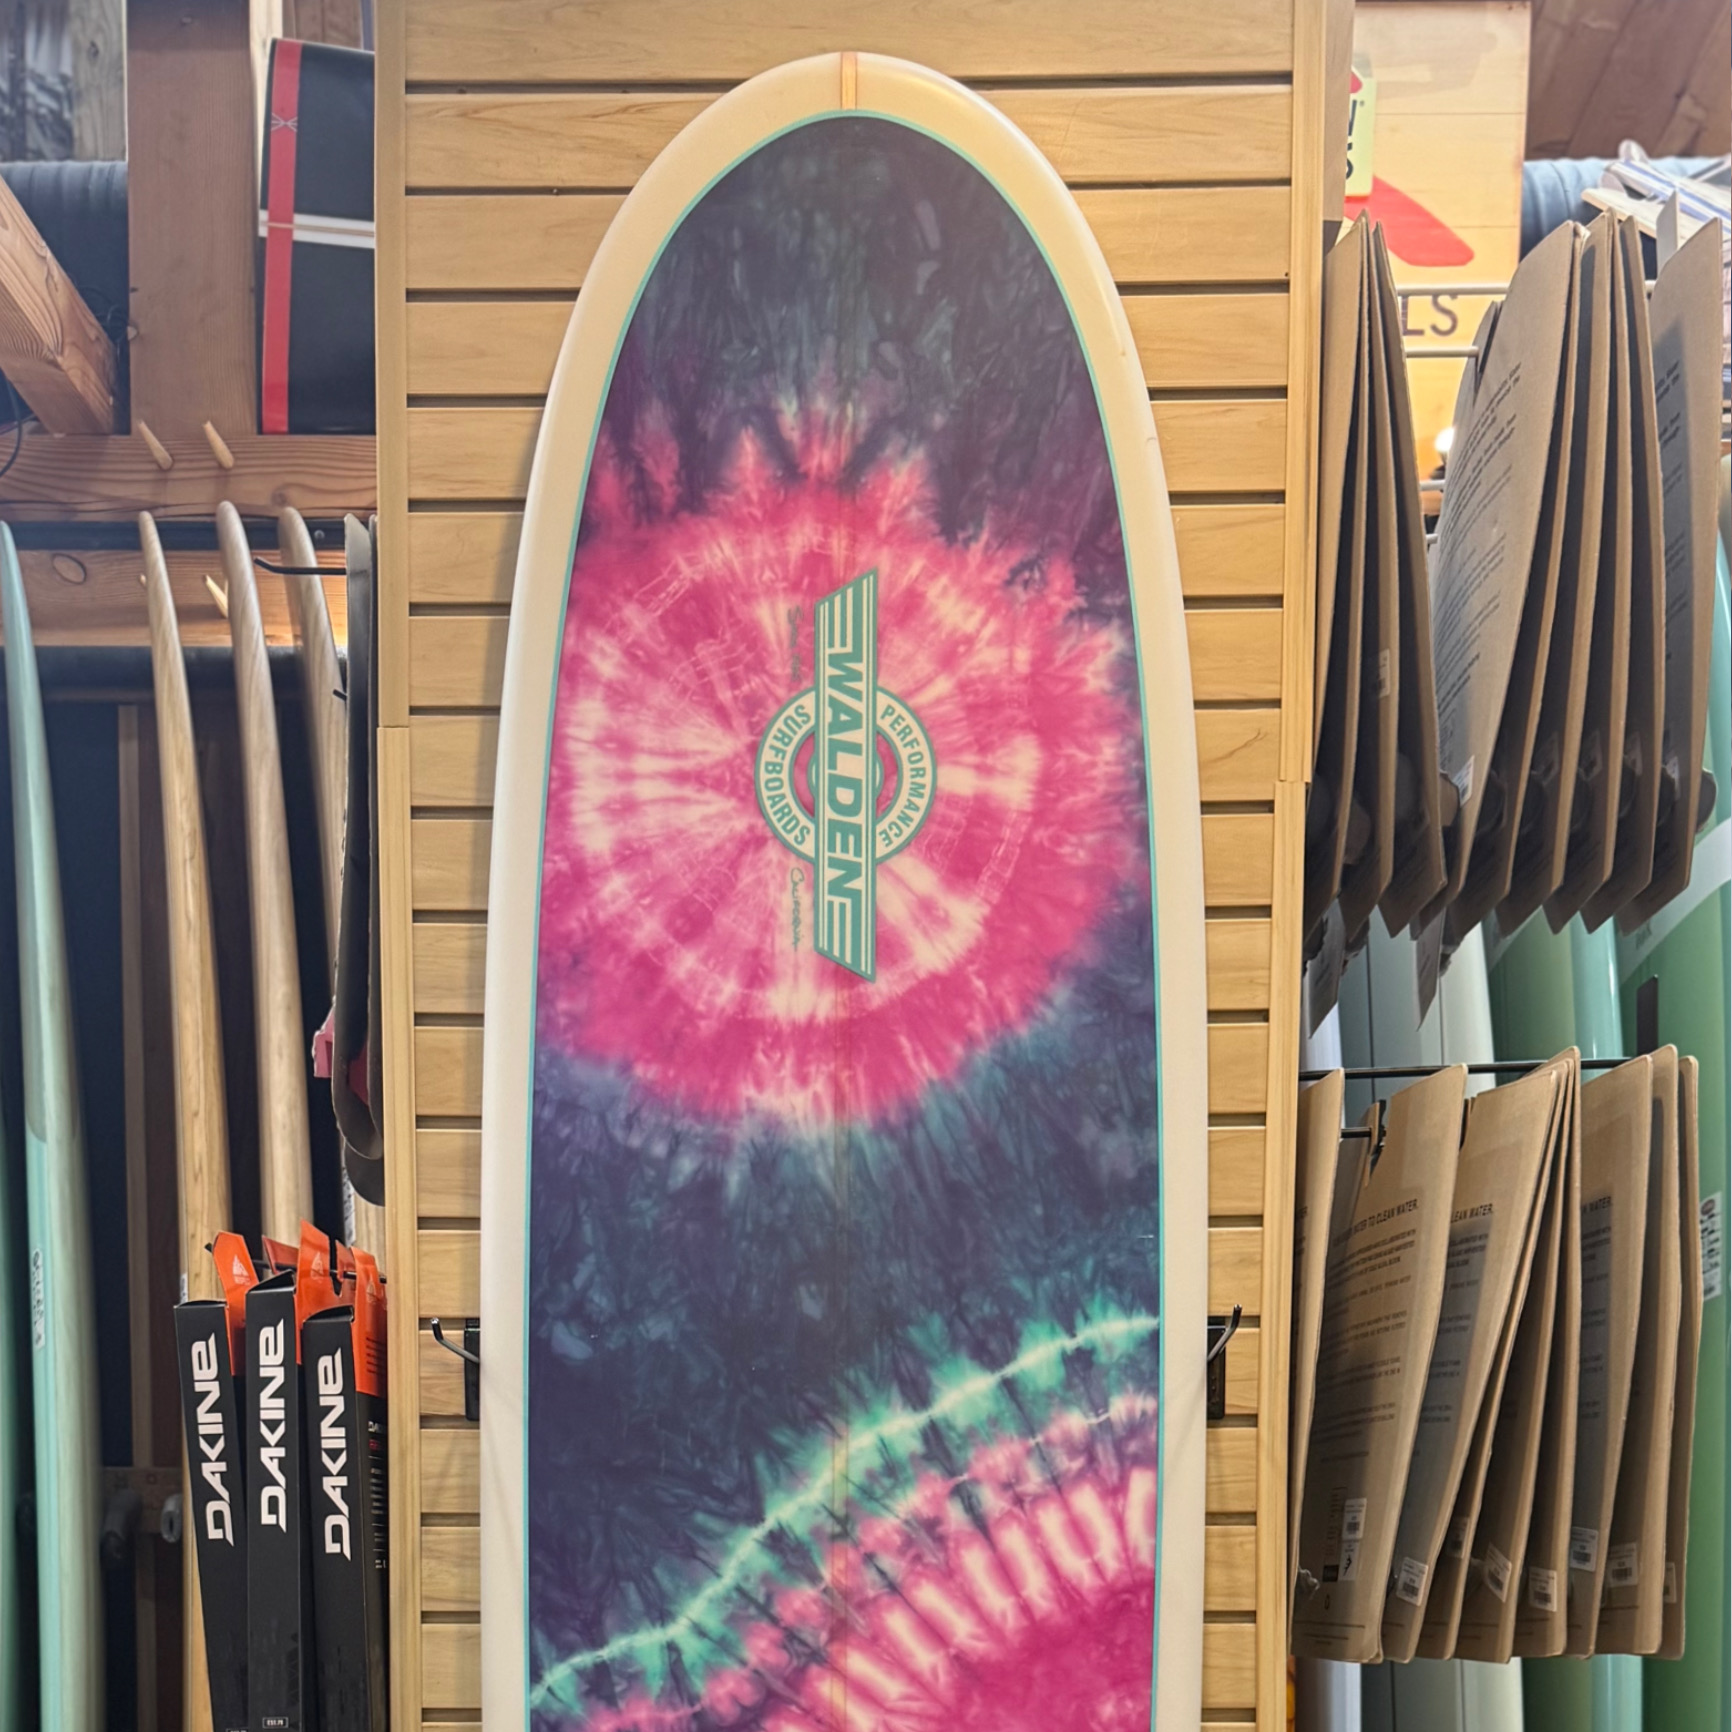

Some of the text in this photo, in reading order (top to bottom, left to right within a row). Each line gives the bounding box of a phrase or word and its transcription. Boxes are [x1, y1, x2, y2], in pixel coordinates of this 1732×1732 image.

[762, 704, 812, 847] SURFBOARDS
[827, 650, 866, 899] WALDEN
[880, 703, 927, 849] PERFORMANCE
[192, 1332, 235, 1547] DAKINE
[259, 1317, 287, 1534] DAKINE
[317, 1346, 352, 1561] DAKINE
